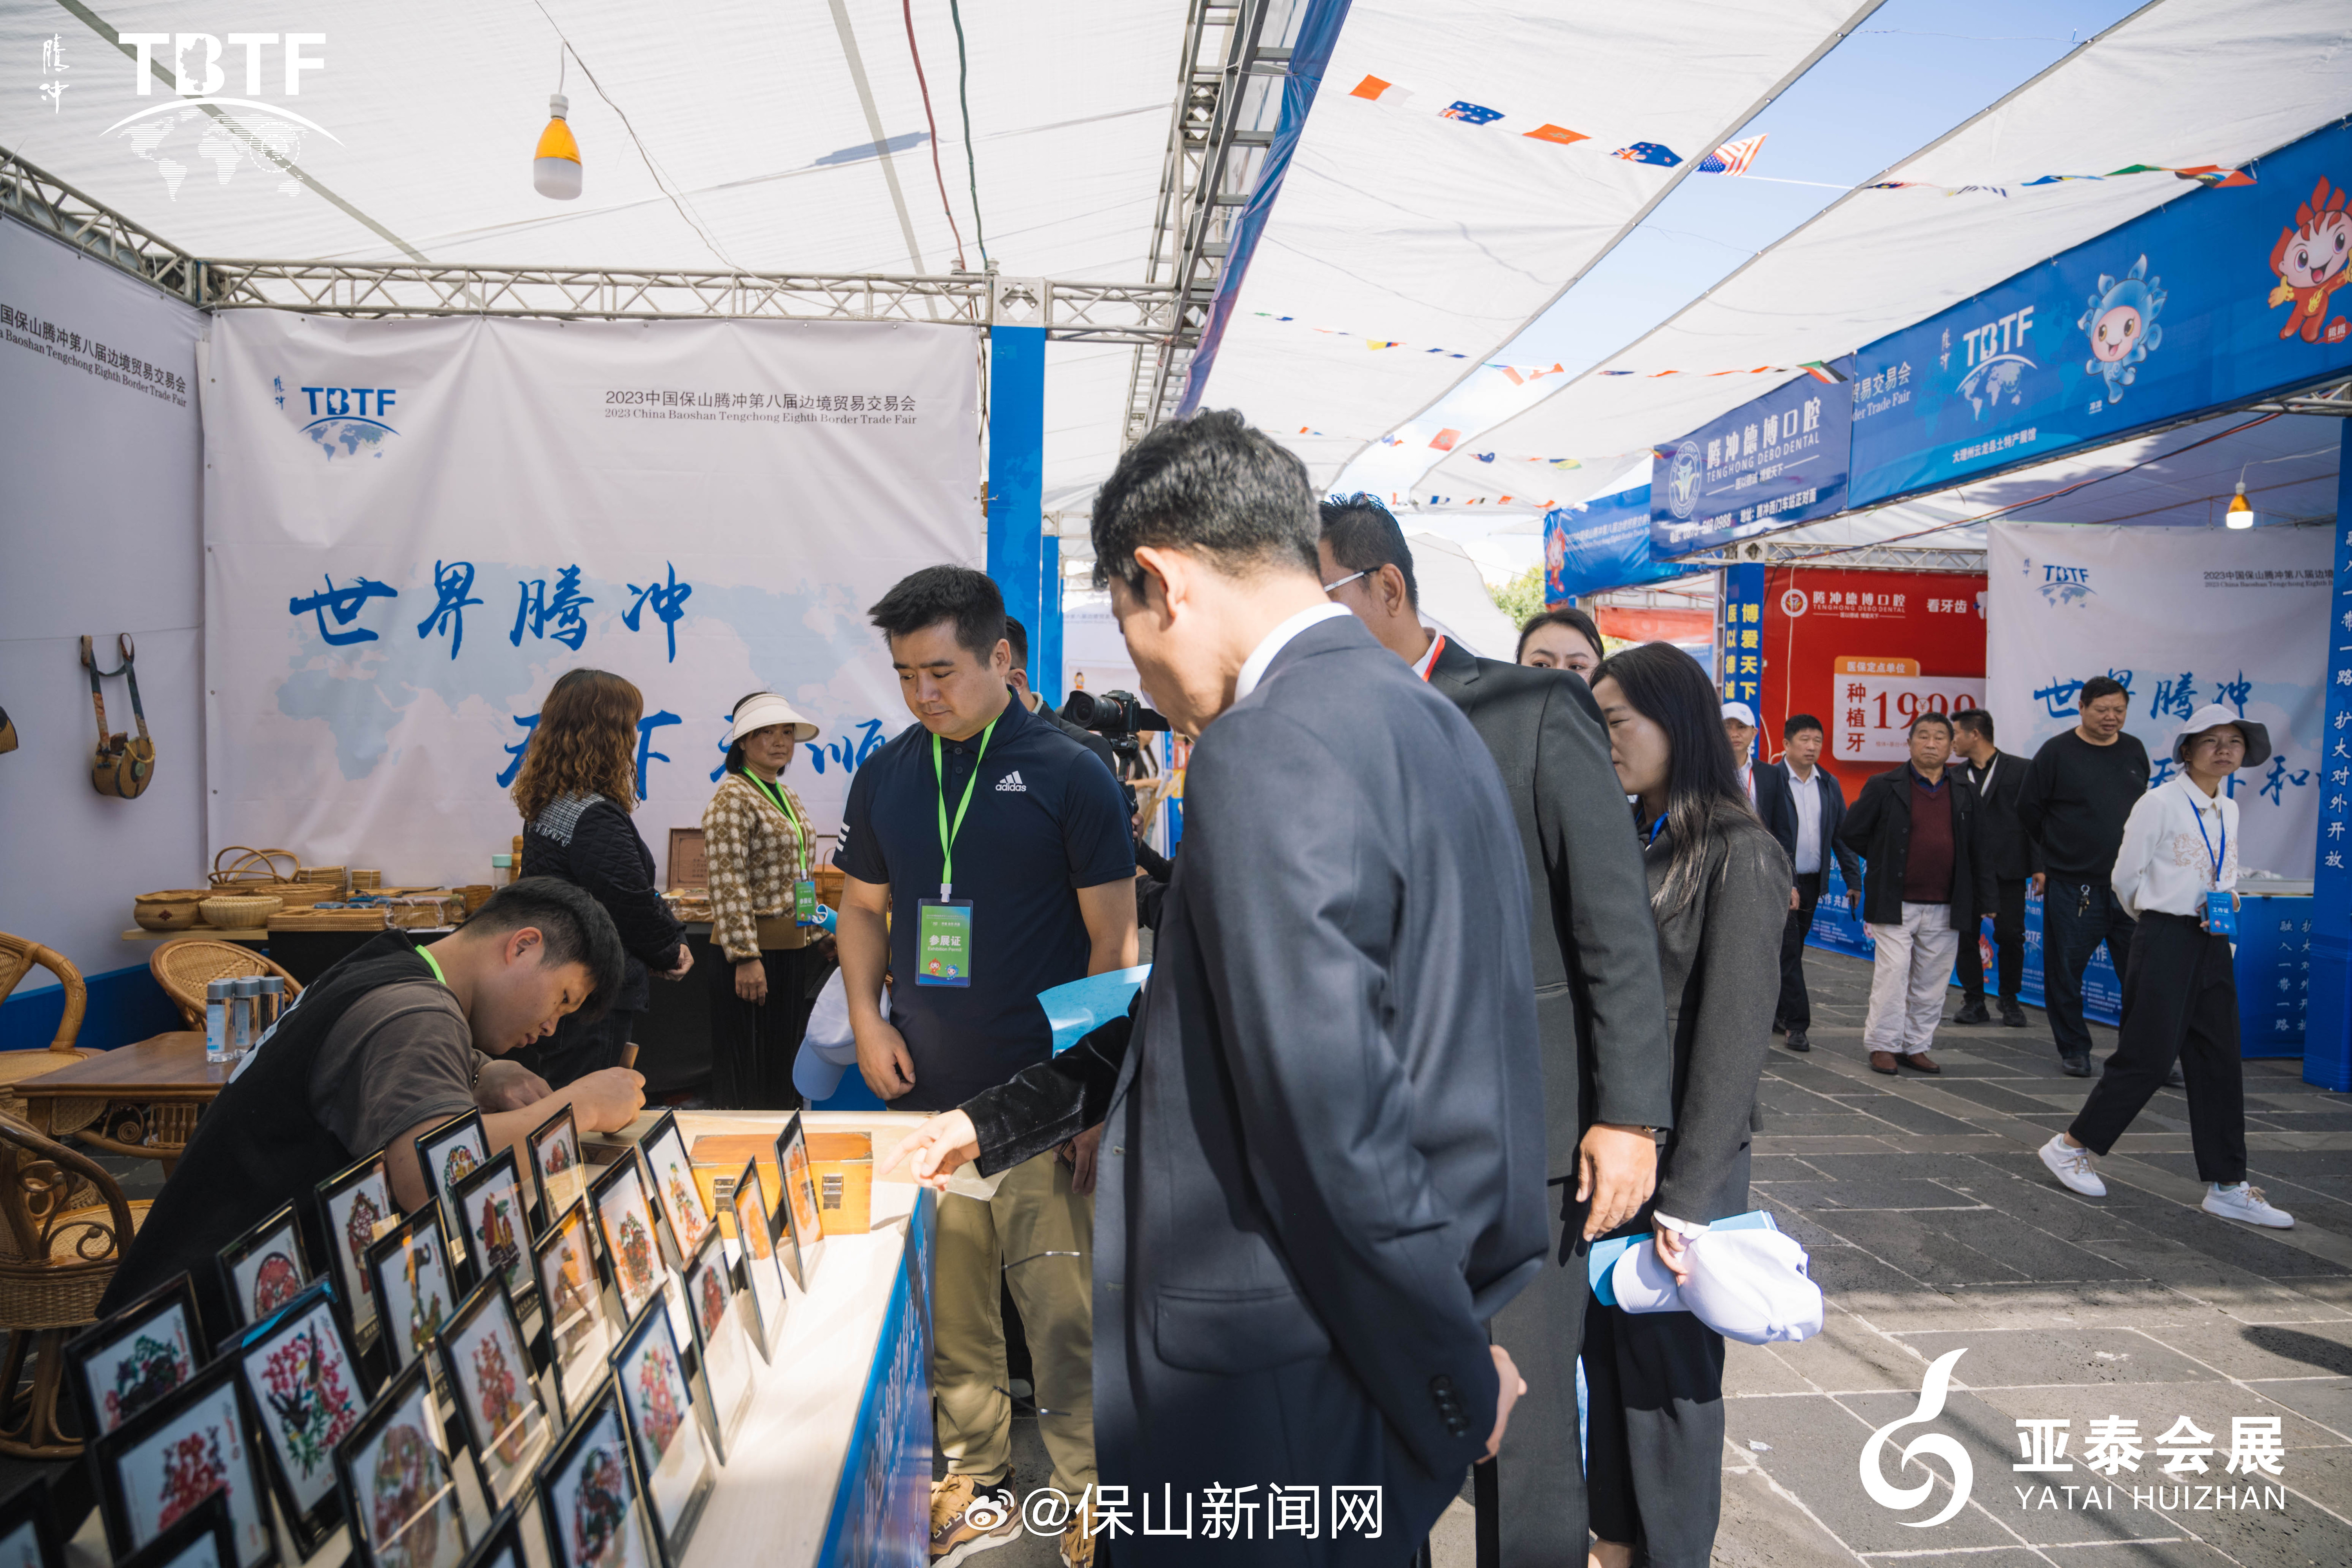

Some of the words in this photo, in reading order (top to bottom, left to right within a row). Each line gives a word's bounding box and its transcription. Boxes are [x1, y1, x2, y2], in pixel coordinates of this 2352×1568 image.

[1963, 305, 2034, 367] TBTF
[6, 330, 45, 354] Baoshan
[46, 345, 93, 375] Tengchong
[95, 364, 121, 383] Eighth
[123, 376, 149, 393] Border
[150, 385, 171, 401] Trade
[172, 394, 187, 408] Fair
[301, 387, 396, 416] TBTF
[605, 409, 631, 418] 2023
[633, 409, 666, 419] China
[669, 410, 717, 420] Baoshan
[719, 411, 780, 423] Tengchong
[783, 412, 817, 424] Eighth
[820, 414, 858, 424] Border
[861, 414, 892, 424] Trade
[895, 414, 917, 425] Fair
[606, 390, 916, 412] 2023中国保山腾冲第八届边境贸易交易会
[1852, 408, 1866, 422] der
[1867, 397, 1891, 416] Trade
[1892, 389, 1911, 407] Fair
[1707, 396, 1821, 470] 腾冲德博口腔
[1707, 456, 1754, 483] TENGHONG
[1758, 445, 1781, 465] DEBO
[1784, 431, 1819, 456] DENTAL
[2043, 565, 2089, 583] TBTF
[289, 559, 692, 663] 世界腾冲
[1813, 591, 1906, 607] 腾冲德博口腔
[1927, 599, 1967, 613] 看牙齿
[1725, 604, 1737, 700] 医以德诚
[1740, 604, 1759, 700] 博爱天下
[1847, 661, 1905, 673] 医保定点单位
[1846, 682, 1866, 752] 种植牙
[995, 782, 1027, 792] adidas
[2325, 711, 2352, 869] 扩大对外开放
[929, 935, 961, 946] 参展证
[2275, 920, 2293, 1031] 融入一带一路
